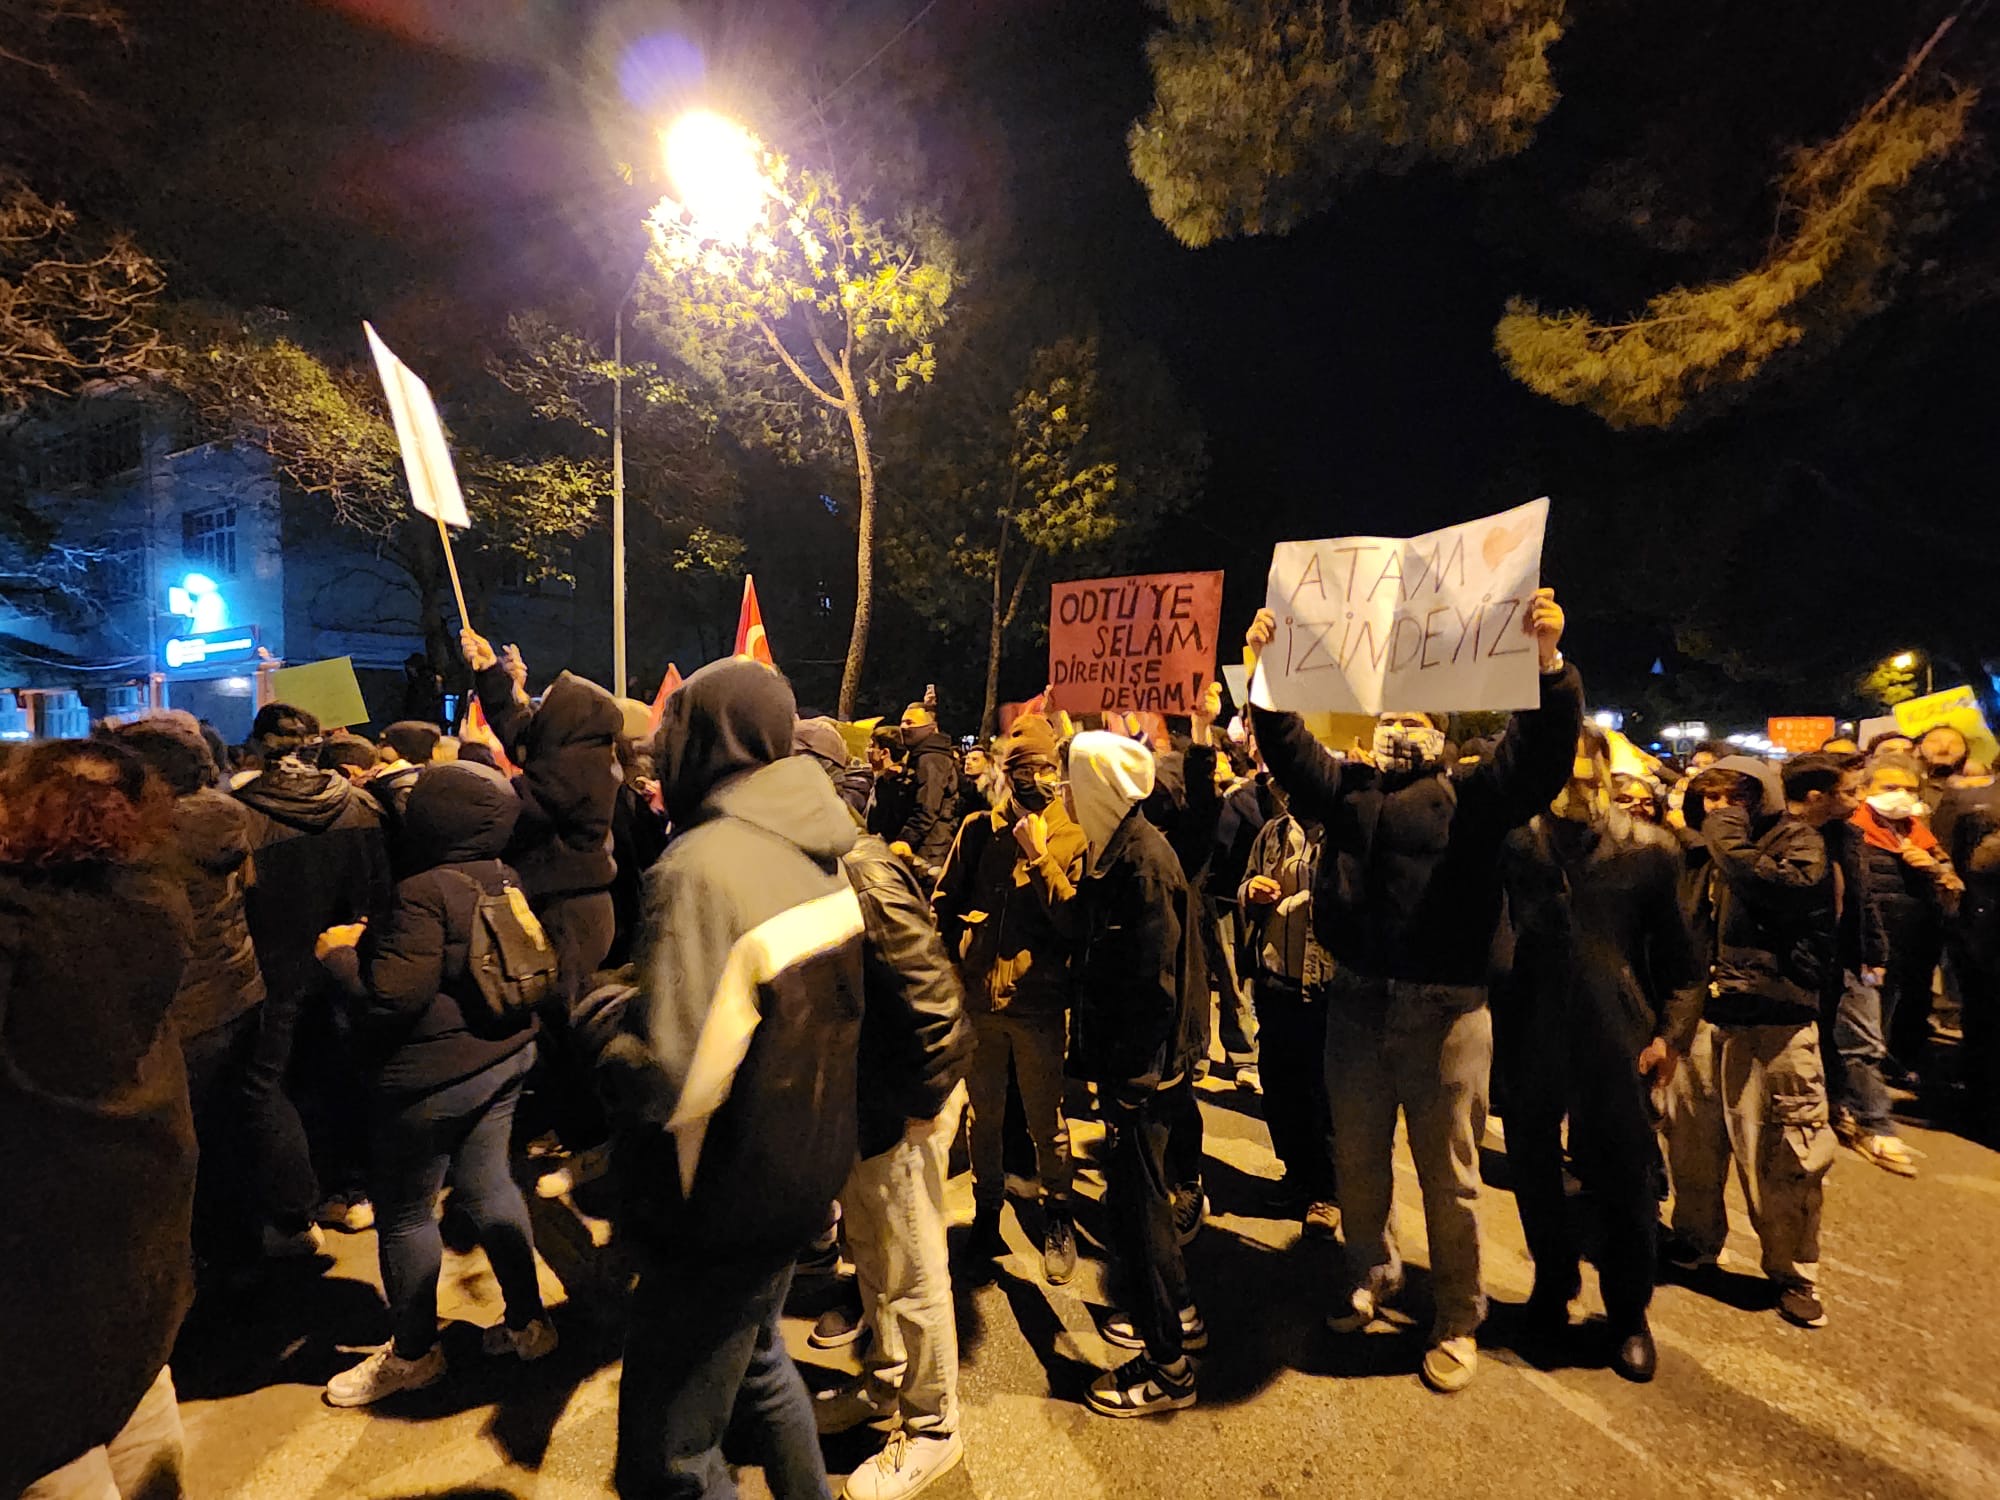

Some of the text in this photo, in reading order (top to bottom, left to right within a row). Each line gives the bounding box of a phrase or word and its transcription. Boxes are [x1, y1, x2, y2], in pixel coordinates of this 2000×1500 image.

[1289, 534, 1465, 604] ATAM
[1060, 580, 1193, 624] ODTÜ'YE
[1092, 621, 1208, 659] SELAM,
[1285, 593, 1530, 677] İZİNDEYİZ
[1101, 672, 1203, 711] DEVAM!
